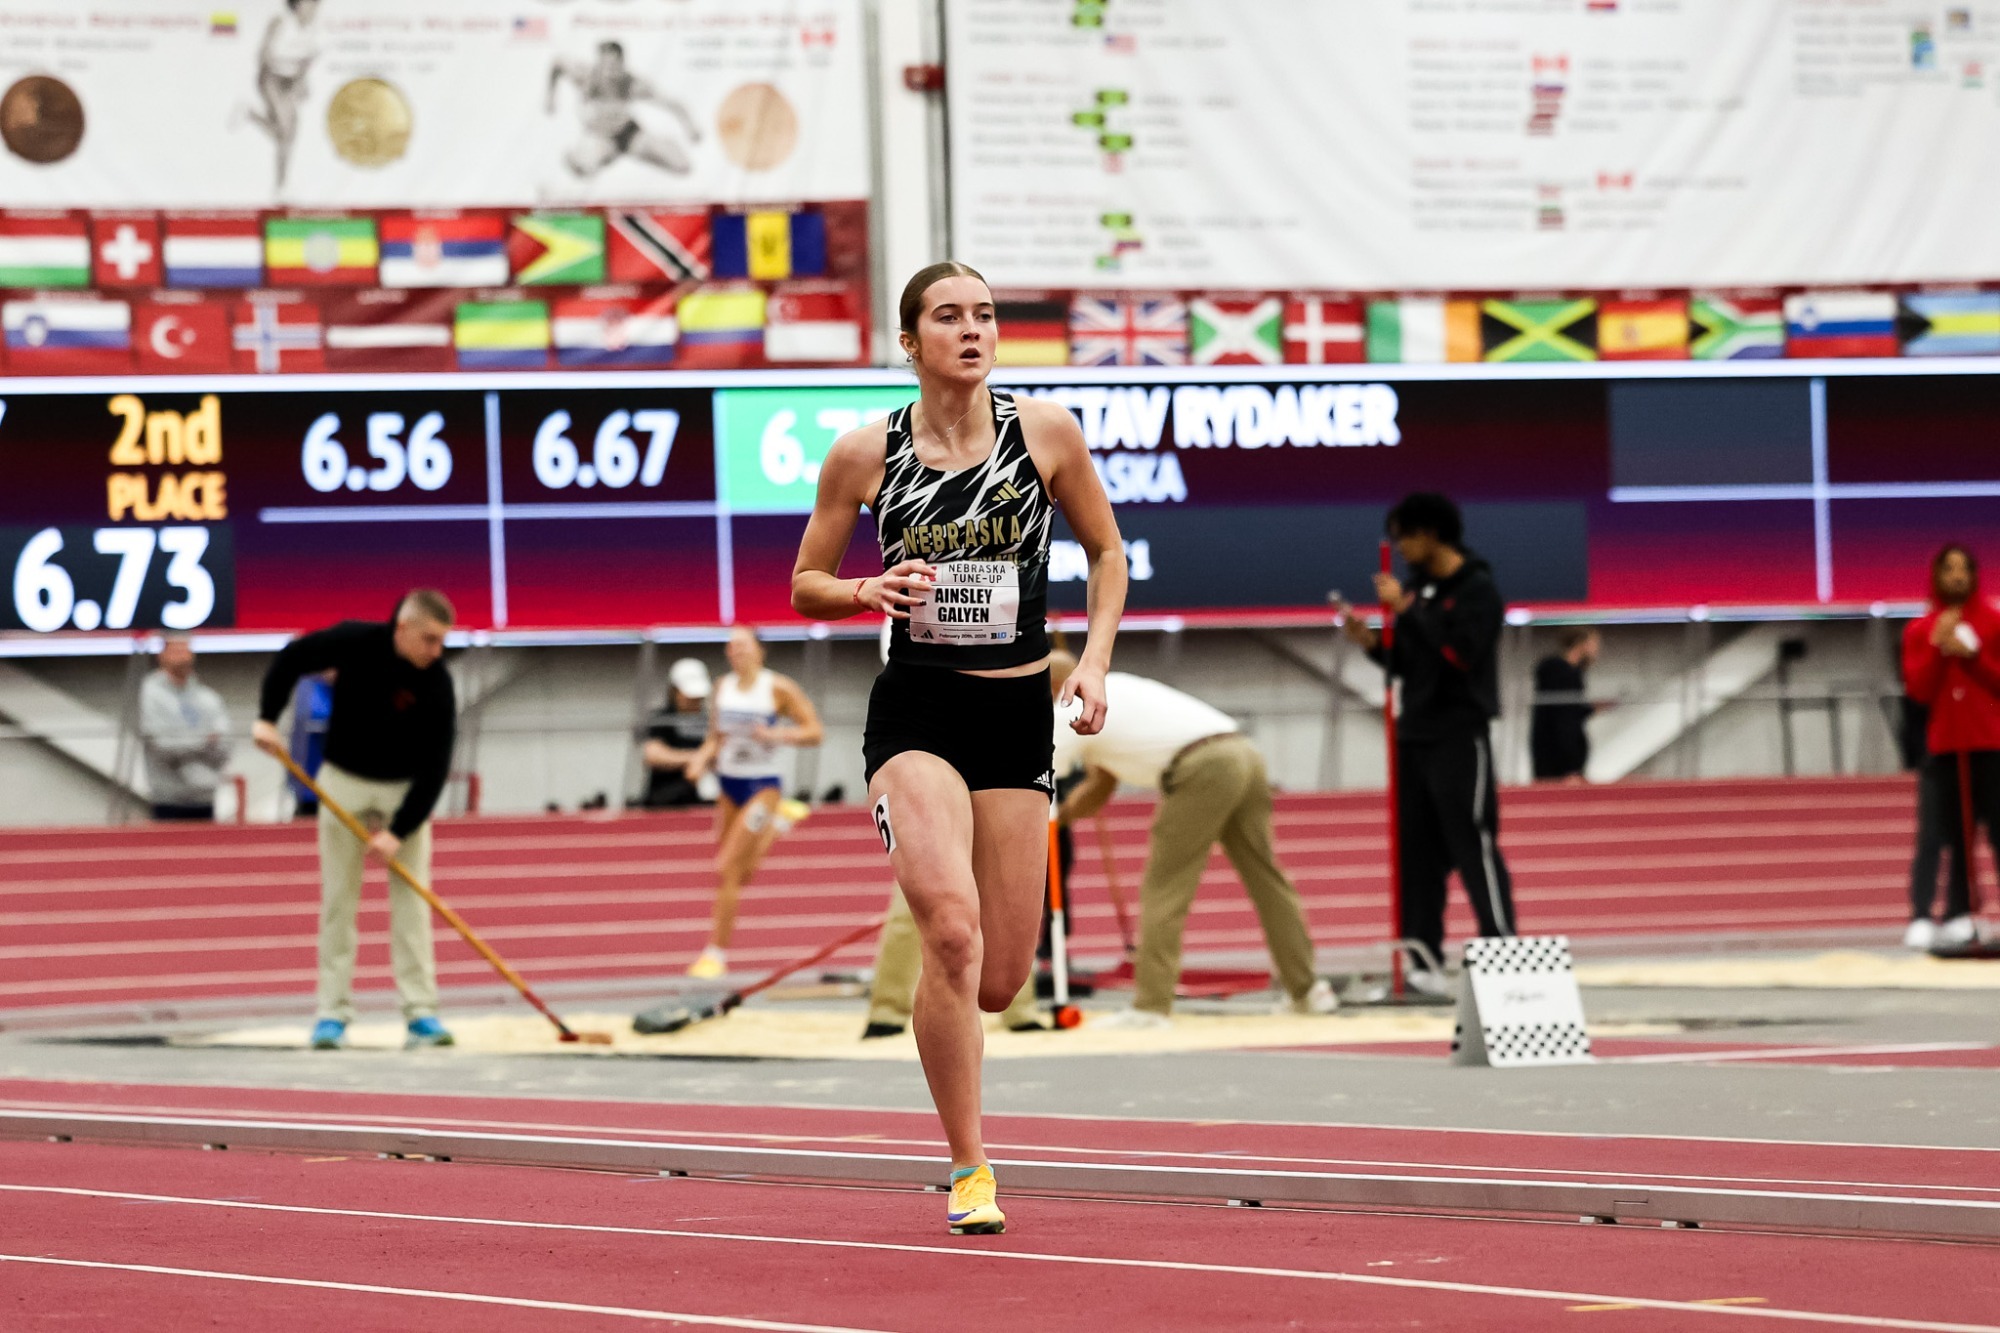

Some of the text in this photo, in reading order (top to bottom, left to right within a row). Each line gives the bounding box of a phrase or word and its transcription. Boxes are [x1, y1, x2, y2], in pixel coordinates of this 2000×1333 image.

[107, 394, 222, 465] 2nd
[1172, 384, 1400, 448] RYDAKER
[301, 412, 453, 492] 6.56
[532, 410, 679, 489] 6.67
[760, 408, 890, 486] 6.7
[107, 472, 227, 521] PLACE
[902, 514, 1023, 556] NEBRASKA
[13, 527, 215, 632] 6.73
[948, 563, 1006, 575] NEBRASKA
[952, 573, 1003, 584] TUNE-UP
[934, 588, 993, 604] AINSLEY
[937, 607, 990, 623] GALYEN
[875, 803, 892, 855] 6
